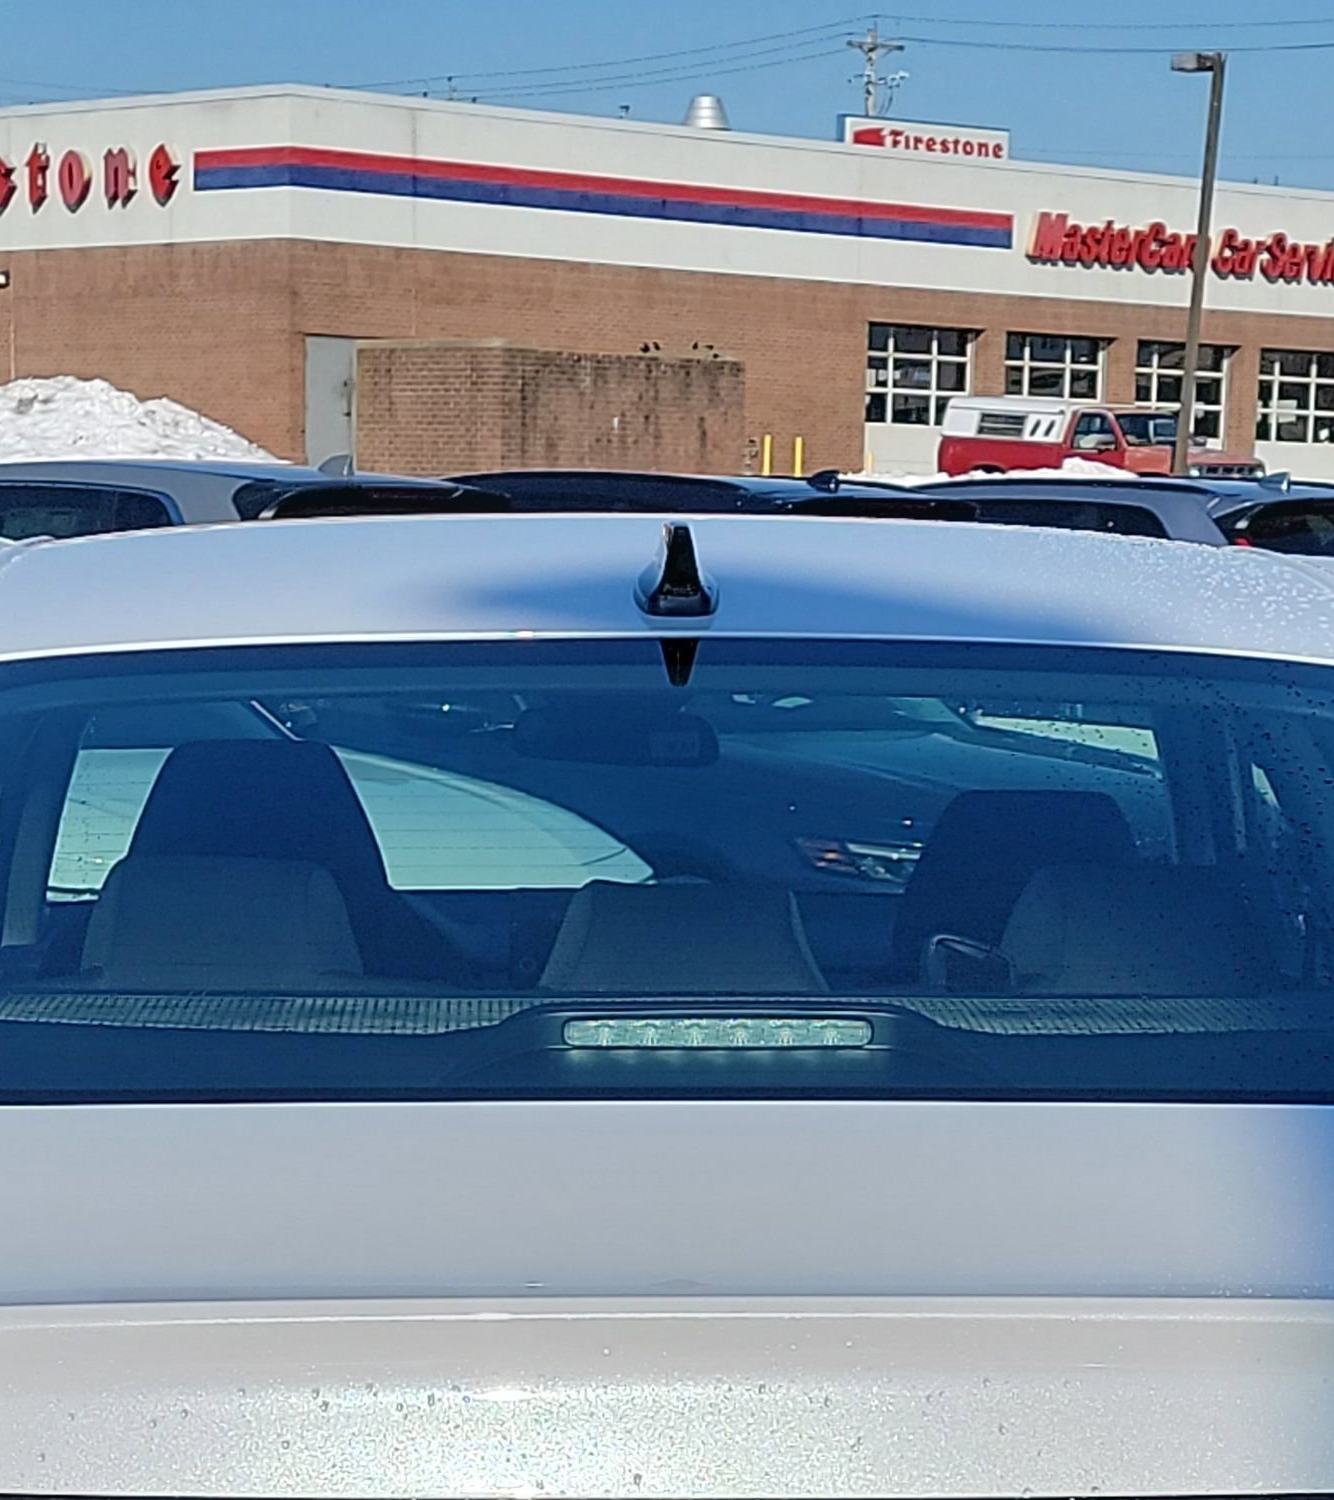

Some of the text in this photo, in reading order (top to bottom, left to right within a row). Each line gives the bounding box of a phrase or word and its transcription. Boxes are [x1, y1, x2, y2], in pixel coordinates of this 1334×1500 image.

[887, 129, 1004, 159] Firestone
[1027, 211, 1213, 275] MasterCar
[1212, 228, 1266, 281] Car
